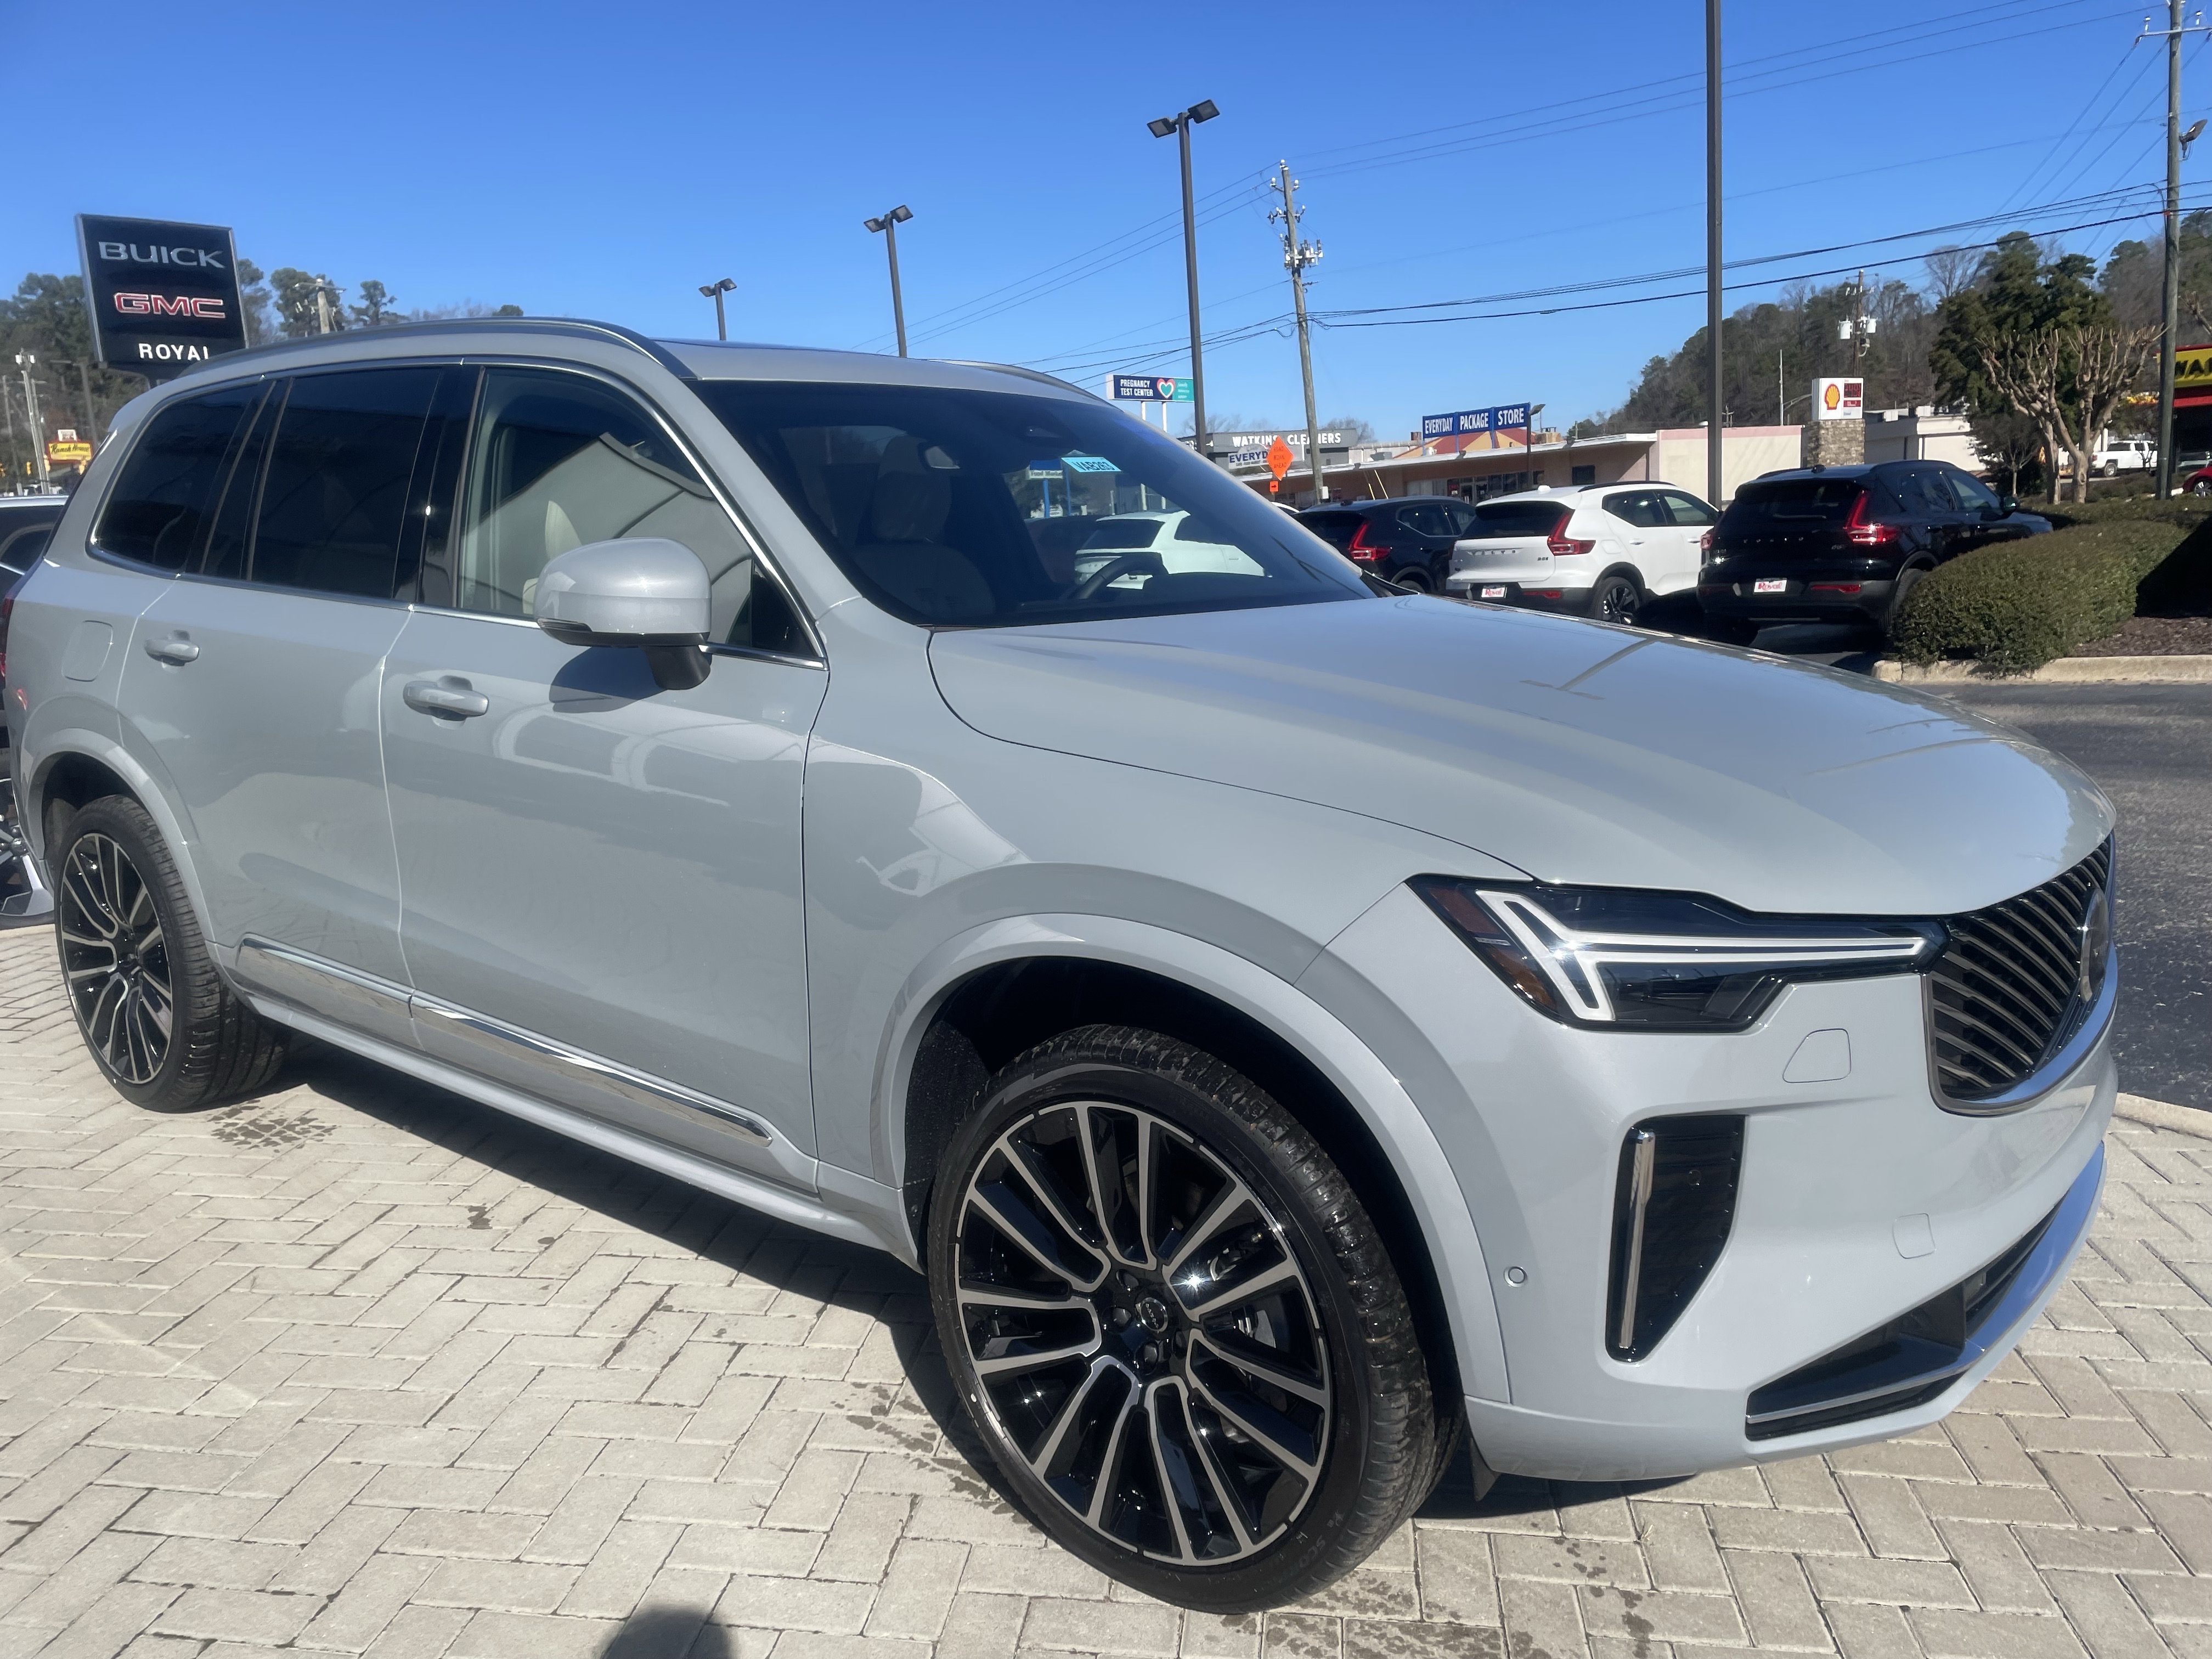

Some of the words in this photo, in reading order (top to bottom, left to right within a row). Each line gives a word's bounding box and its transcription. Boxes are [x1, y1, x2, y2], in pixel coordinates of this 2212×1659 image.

[99, 241, 226, 269] BUICK
[114, 292, 225, 319] GMC
[1120, 379, 1150, 388] PREGNANCY
[1120, 388, 1133, 396] TEST
[1134, 388, 1154, 397] CENTER
[1425, 417, 1453, 434] EVERYDAY
[1460, 413, 1489, 431] PACKAGE
[1498, 408, 1525, 426] STORE
[1229, 450, 1268, 463] EVERYD
[1758, 582, 1782, 591] Royal
